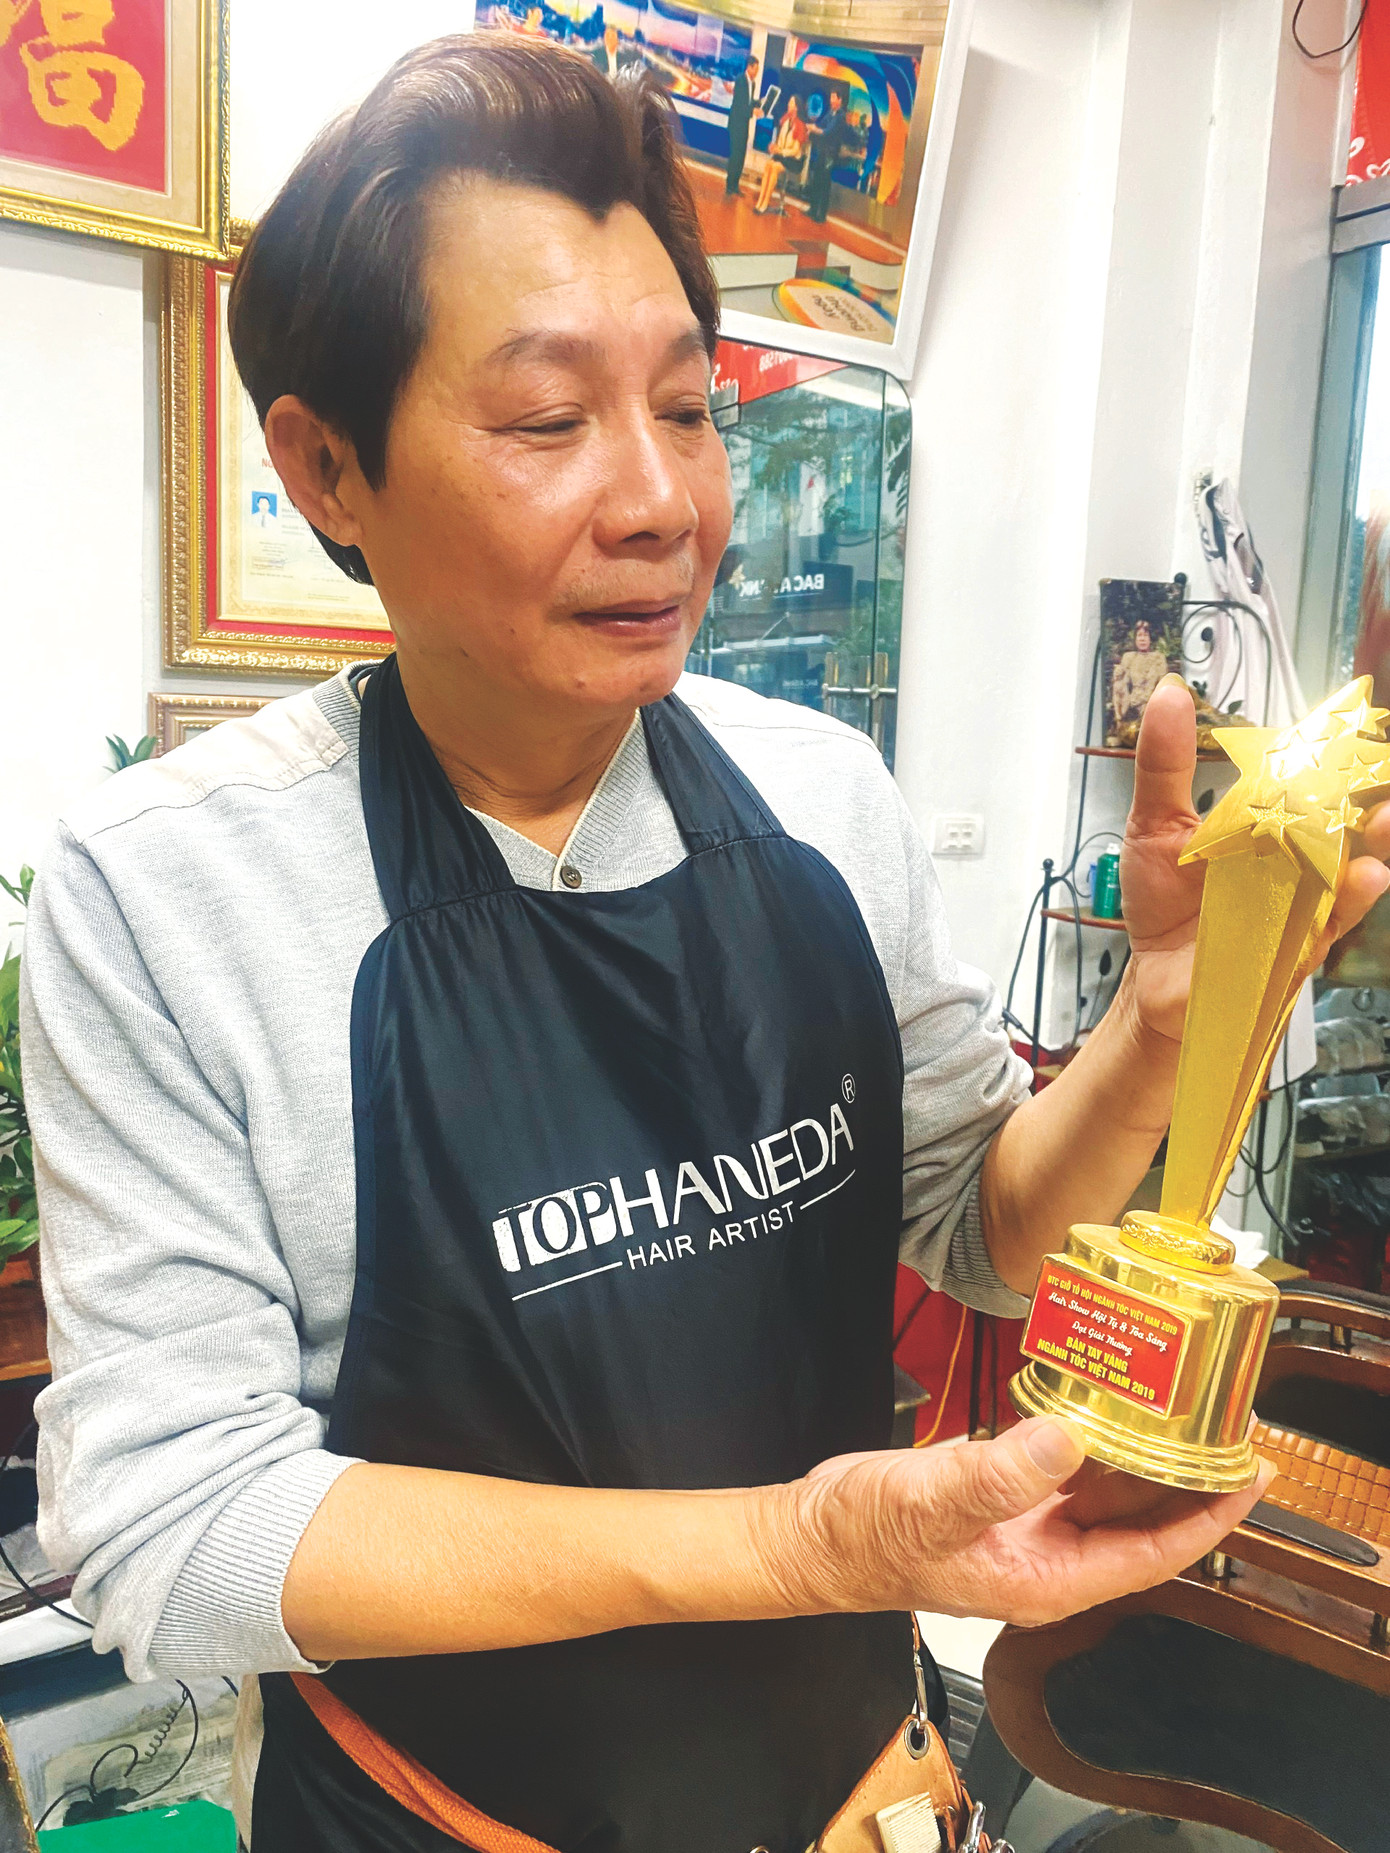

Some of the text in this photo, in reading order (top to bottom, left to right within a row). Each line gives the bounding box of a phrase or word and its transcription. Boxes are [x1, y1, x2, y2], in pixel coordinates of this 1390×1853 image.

[626, 1201, 795, 1270] HAIR ARTIST
[1048, 1292, 1067, 1307] Hair
[1068, 1300, 1090, 1316] Show
[1119, 1322, 1128, 1333] &
[1130, 1308, 1145, 1322] VIỆT
[1144, 1314, 1161, 1329] NAM
[1161, 1321, 1178, 1336] 2019
[1036, 1338, 1156, 1401] NGÀNH TÓC VIỆT NAM 2019
[1087, 1345, 1103, 1361] TAY
[1103, 1352, 1128, 1373] VÀNG
